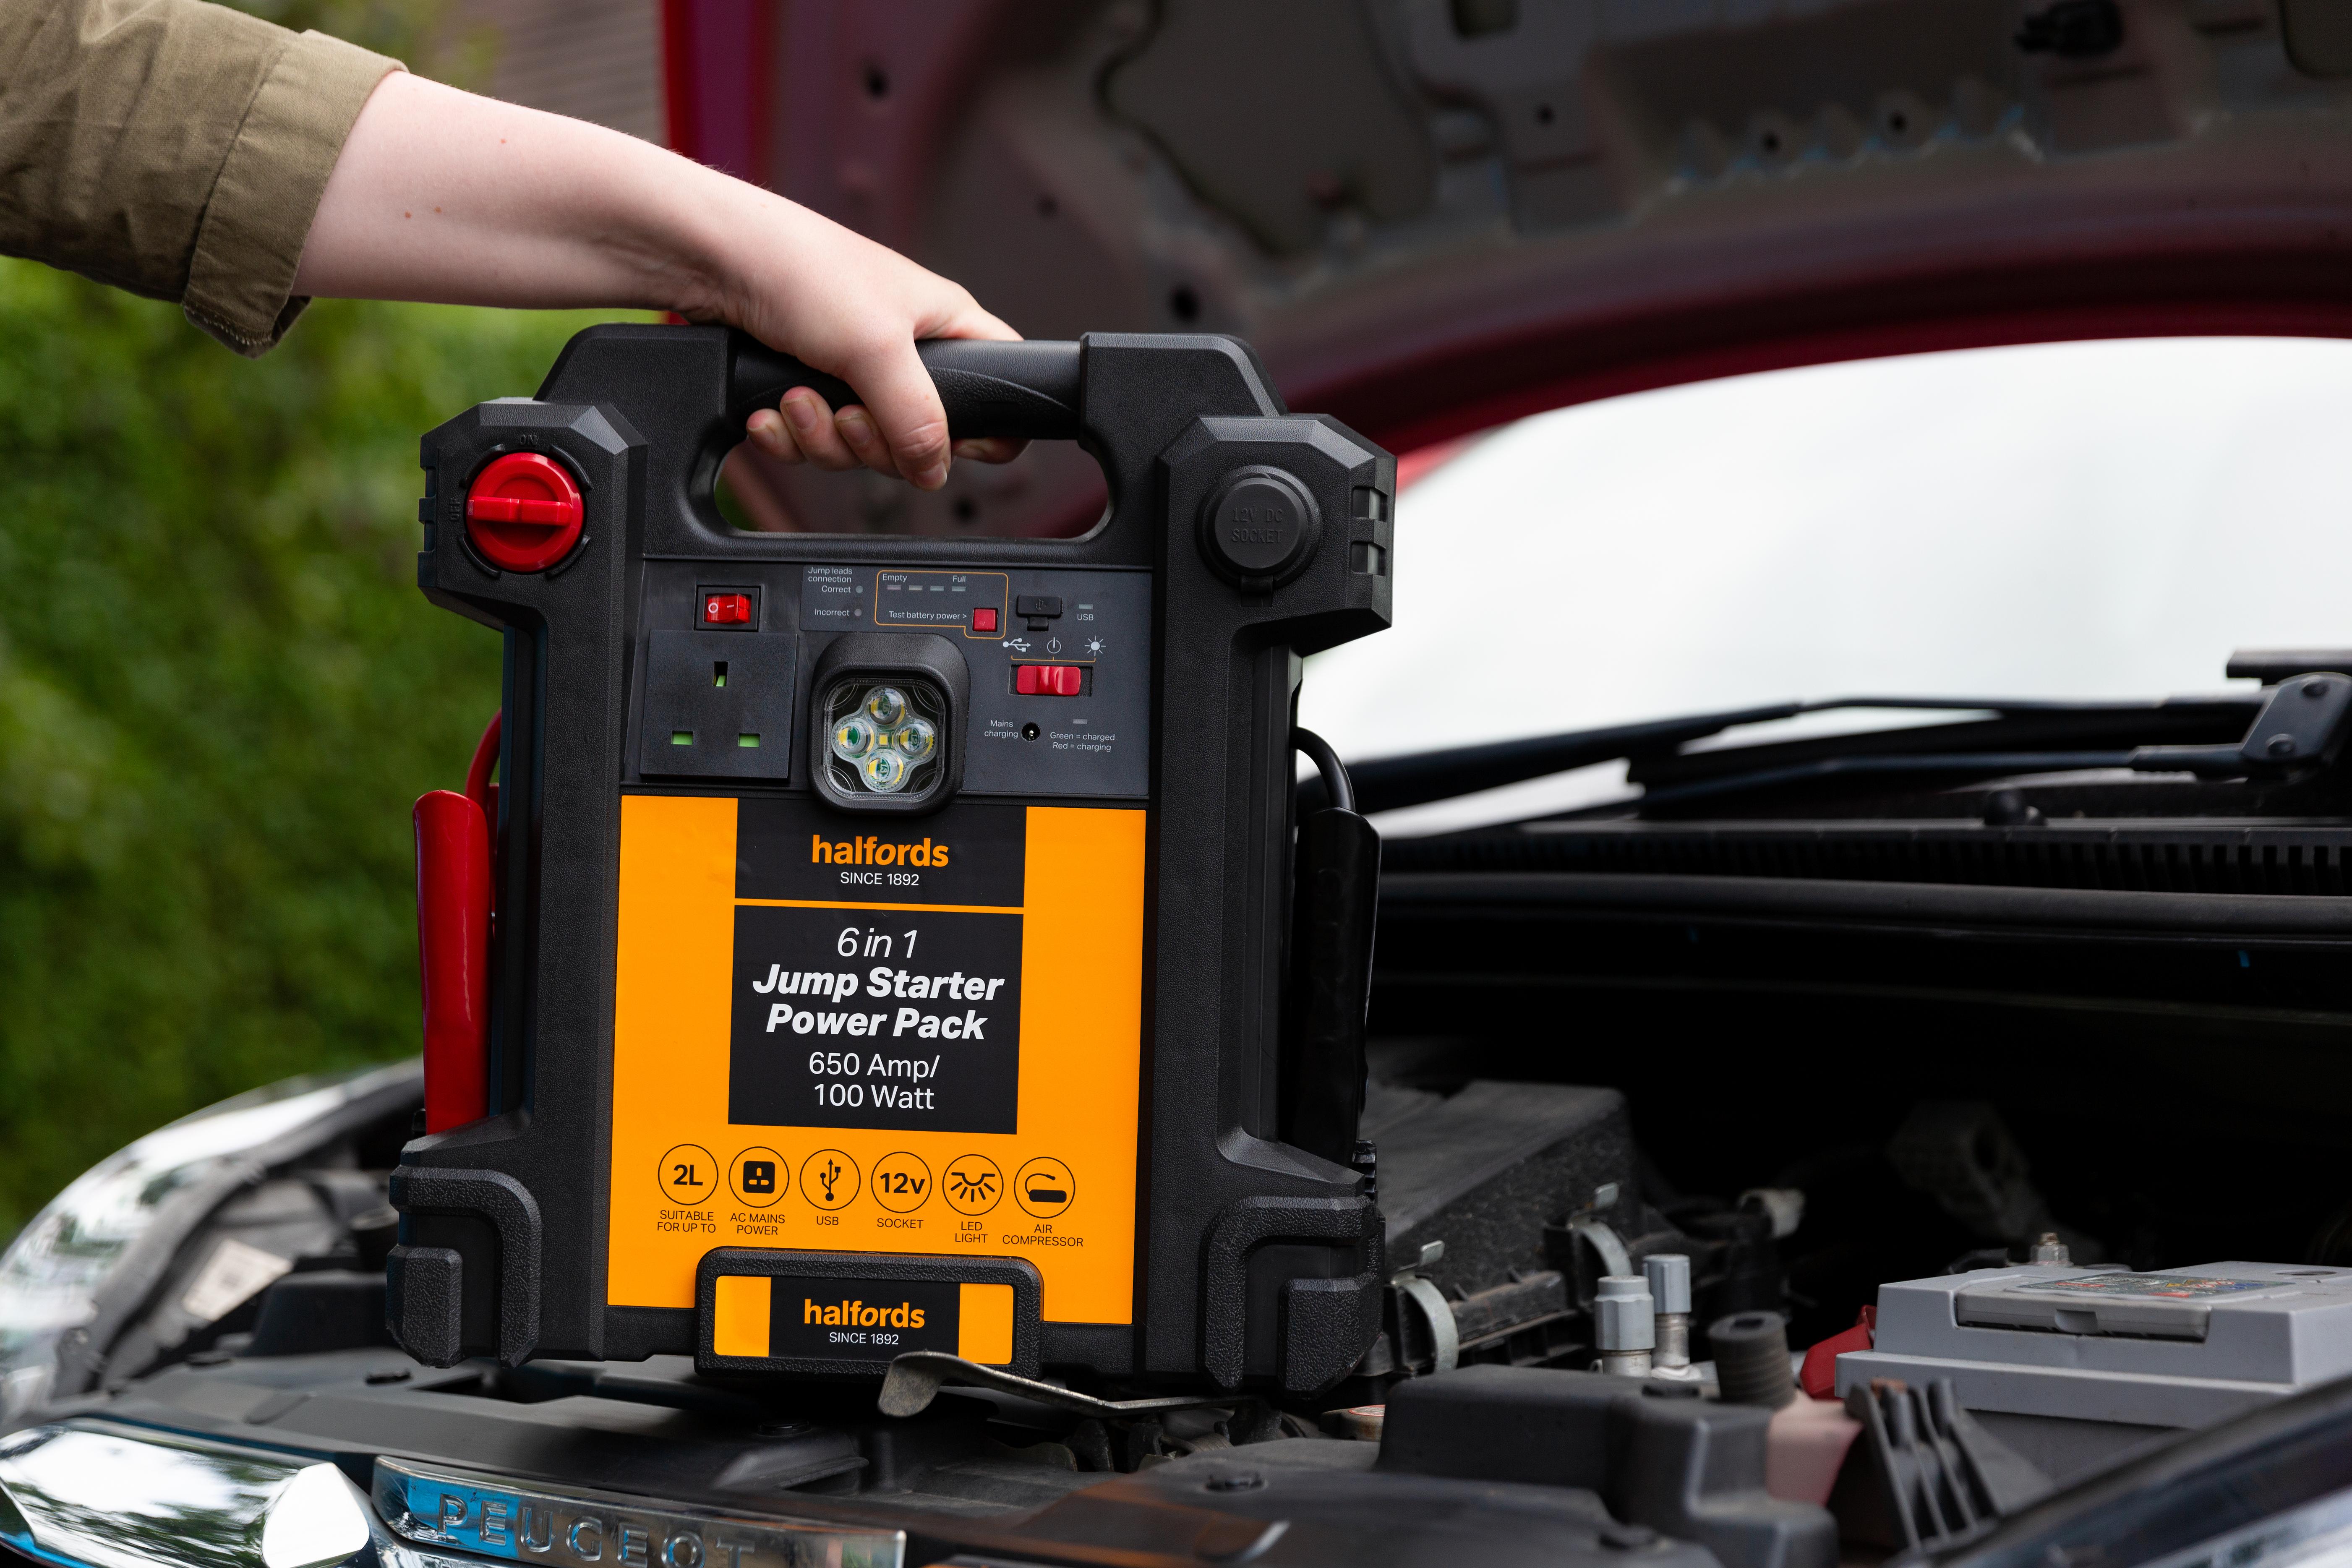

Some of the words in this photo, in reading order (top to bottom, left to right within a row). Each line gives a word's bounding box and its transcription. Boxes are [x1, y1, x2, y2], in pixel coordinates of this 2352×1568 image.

[1264, 508, 1283, 523] DC
[1232, 528, 1283, 544] SOCKET
[808, 567, 830, 575] Jump
[882, 574, 907, 582] Empty
[906, 611, 935, 620] battery
[984, 730, 1018, 739] charging
[1083, 733, 1115, 742] charged
[1077, 743, 1111, 752] charging
[812, 835, 949, 867] halfords
[840, 871, 882, 884] SINCE
[887, 873, 919, 886] 1892
[838, 927, 860, 957] 6
[864, 928, 892, 957] in
[904, 930, 917, 958] 1
[752, 964, 859, 1003] Jump
[866, 967, 1005, 1000] Starter
[766, 1003, 888, 1036] Power
[893, 1007, 988, 1040] Pack
[809, 1051, 860, 1075] 650
[867, 1054, 940, 1083] Amp/
[814, 1083, 863, 1107] 100
[871, 1085, 934, 1109] Watt
[673, 1164, 703, 1186] 2L
[880, 1172, 926, 1194] 12v
[660, 1210, 714, 1221] SUITABLE
[730, 1213, 746, 1222] AC
[749, 1213, 785, 1224] MAINS
[816, 1216, 839, 1226] USB
[657, 1221, 679, 1231] FOR
[683, 1223, 698, 1232] UP
[700, 1223, 716, 1233] TO
[877, 1218, 924, 1229] SOCKET
[961, 1221, 982, 1231] LED
[1034, 1224, 1052, 1234] AIR
[737, 1225, 778, 1235] POWER
[955, 1233, 988, 1243] LIGHT
[1002, 1234, 1083, 1247] COMPRESSOR
[804, 1299, 925, 1328] halfords
[829, 1332, 867, 1344] SINCE
[870, 1333, 899, 1345] 1892
[437, 1493, 754, 1568] PEUGEOT
